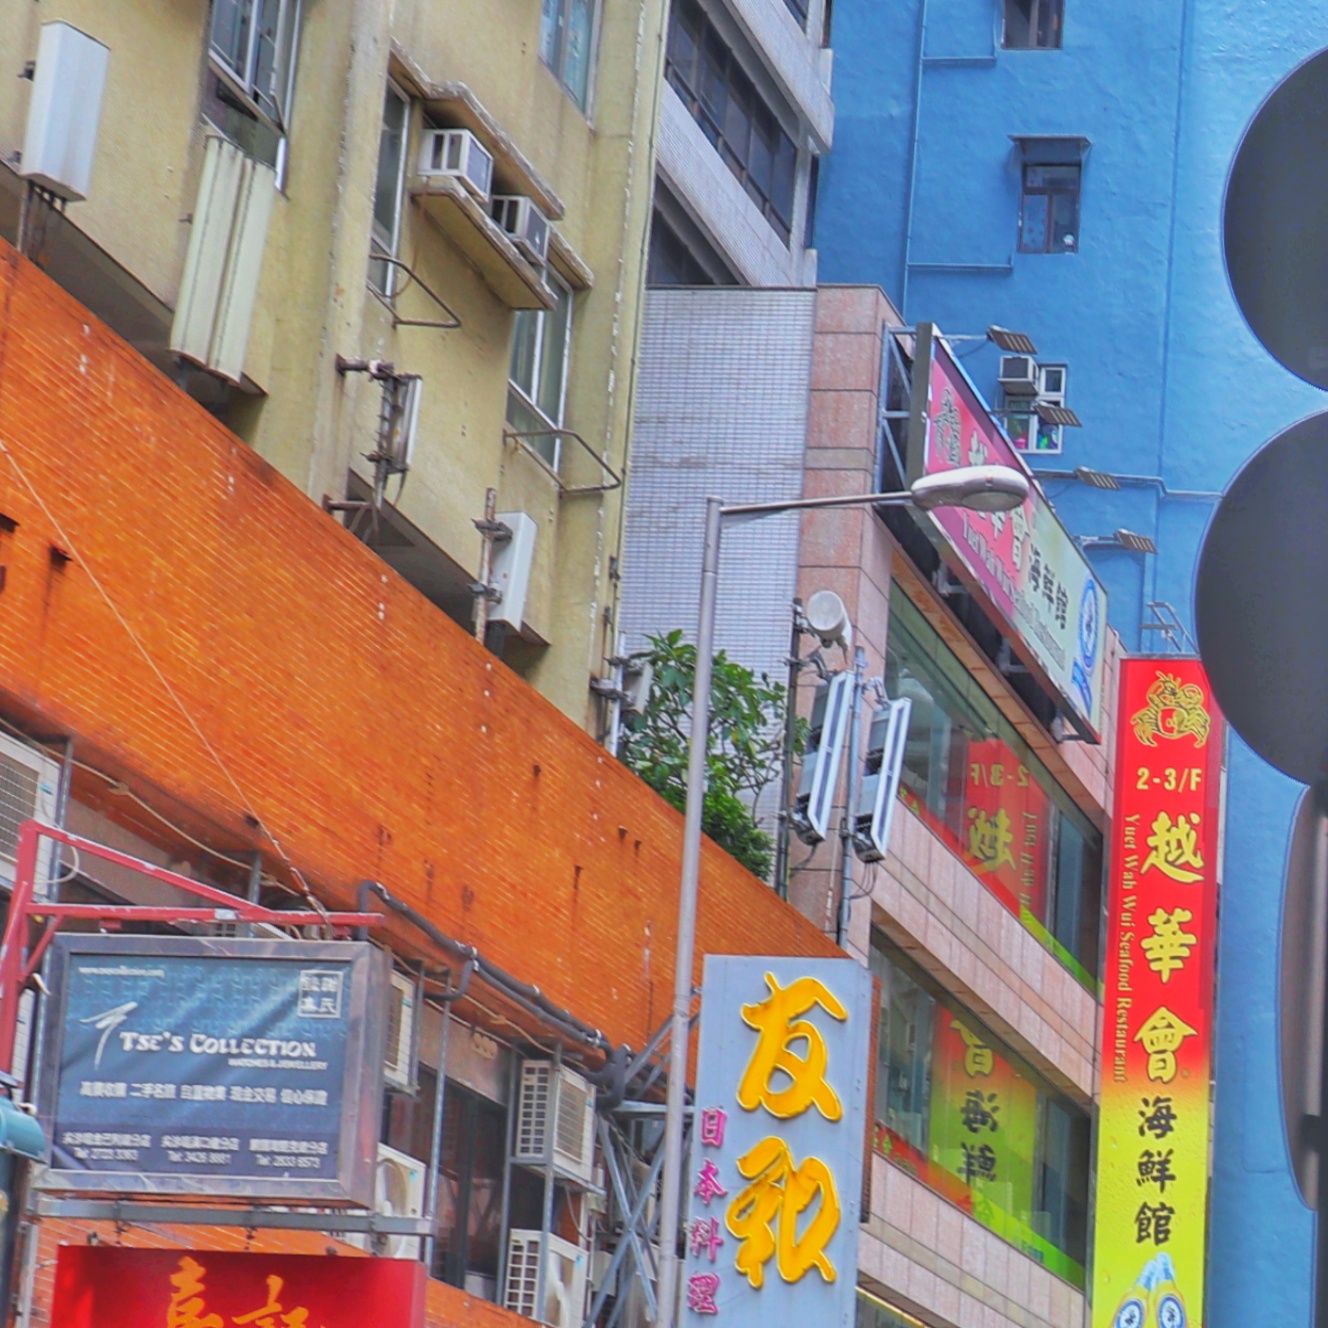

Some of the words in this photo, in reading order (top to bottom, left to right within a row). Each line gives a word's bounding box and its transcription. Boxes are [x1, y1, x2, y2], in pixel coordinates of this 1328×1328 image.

[1136, 766, 1203, 791] 2-3/F
[1117, 930, 1136, 993] Seafood
[1133, 810, 1205, 1084] 越華會
[1113, 994, 1134, 1085] Restaurant
[687, 1105, 729, 1316] 日本料理
[1134, 1095, 1178, 1247] 海鮮館
